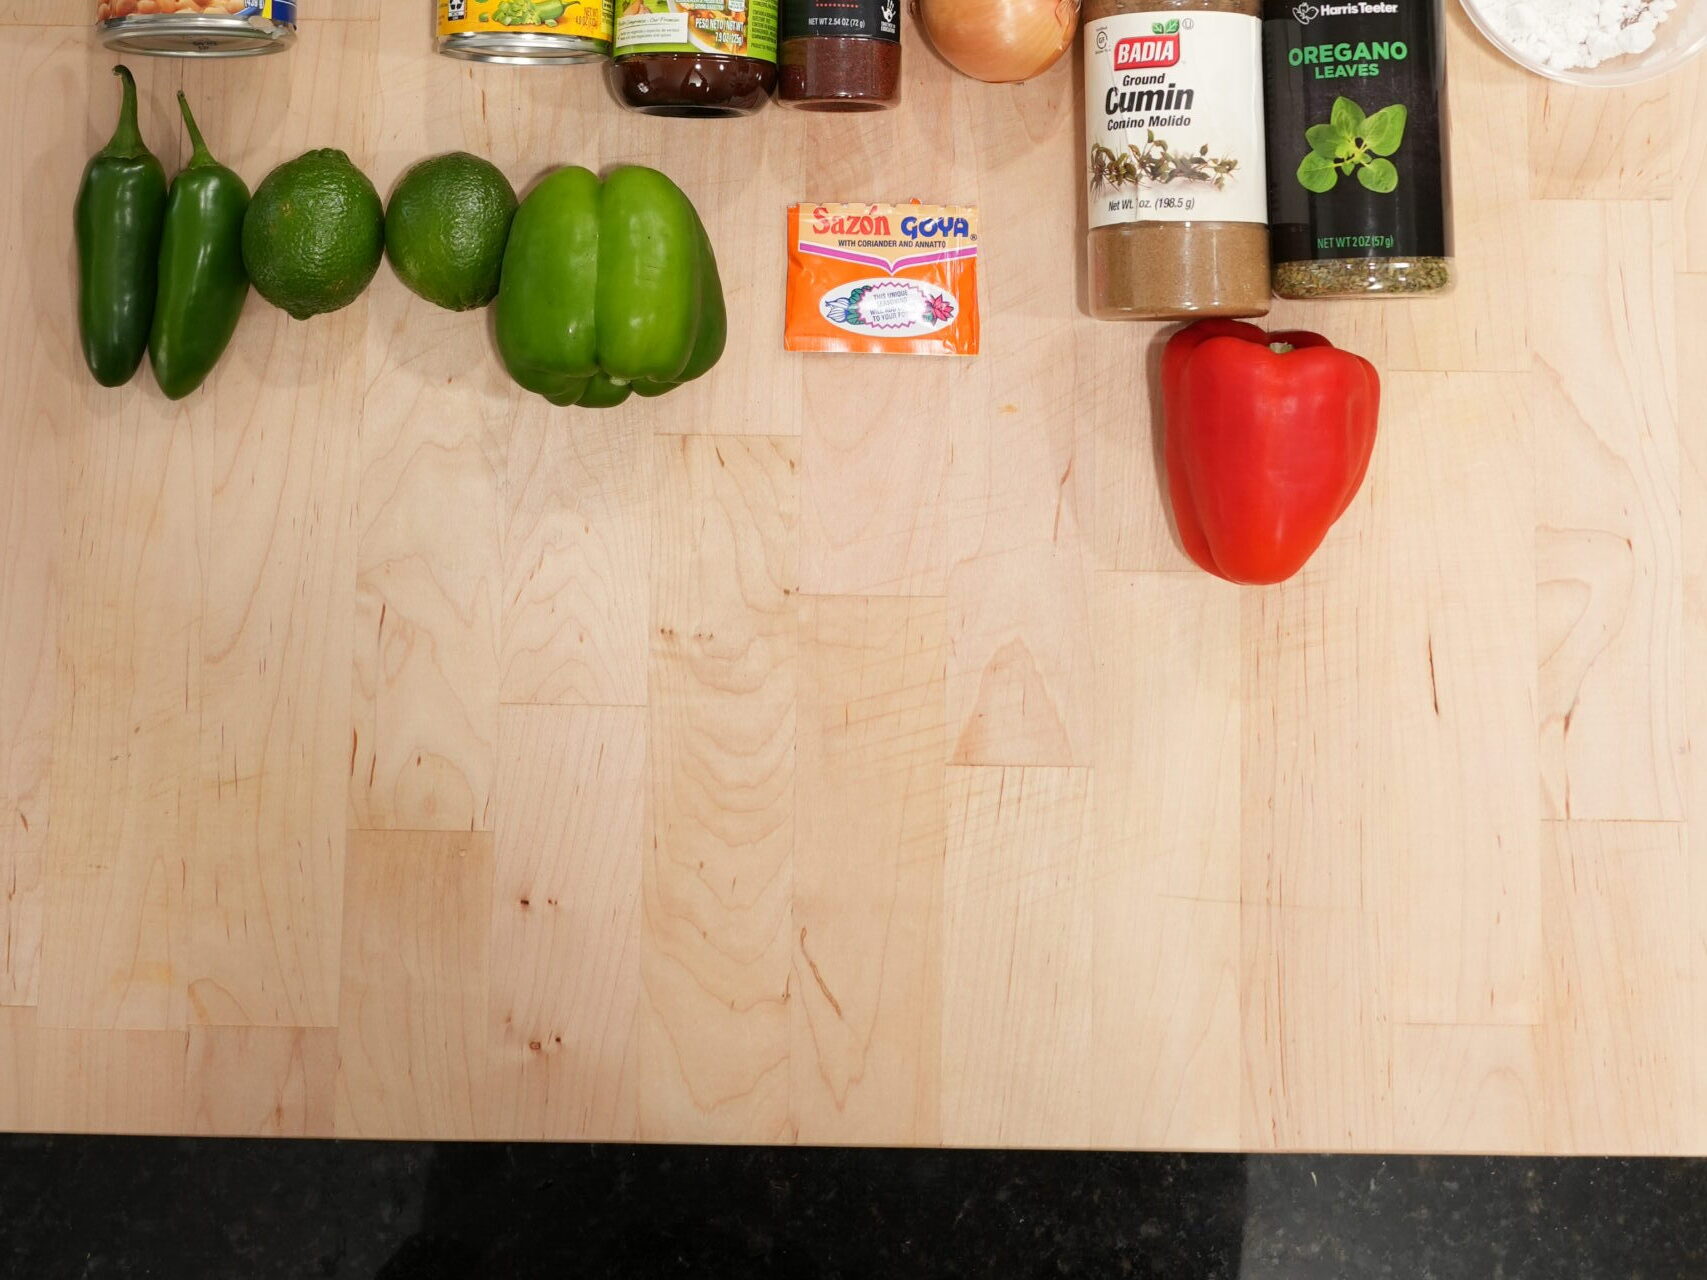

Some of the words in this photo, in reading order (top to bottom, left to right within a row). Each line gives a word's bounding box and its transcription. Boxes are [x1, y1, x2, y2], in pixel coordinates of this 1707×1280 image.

[1320, 3, 1358, 17] Harris
[1358, 1, 1398, 15] Teeter
[808, 18, 818, 26] NET
[819, 18, 828, 26] WT
[828, 18, 841, 26] 2.54
[841, 18, 850, 26] OZ
[1117, 40, 1174, 64] BADIA
[1288, 41, 1408, 67] OREGANO
[1315, 63, 1379, 80] LEAVES
[1123, 73, 1166, 86] Ground
[1105, 83, 1194, 115] Cumin
[1148, 115, 1191, 127] Molido
[1108, 201, 1120, 211] Net
[1138, 199, 1152, 208] oz.
[1154, 197, 1184, 211] (198.5
[813, 205, 890, 236] Sazón
[901, 216, 969, 240] GOYA
[915, 240, 946, 248] ANNATTO
[1317, 237, 1333, 248] NET
[1336, 236, 1351, 247] WT
